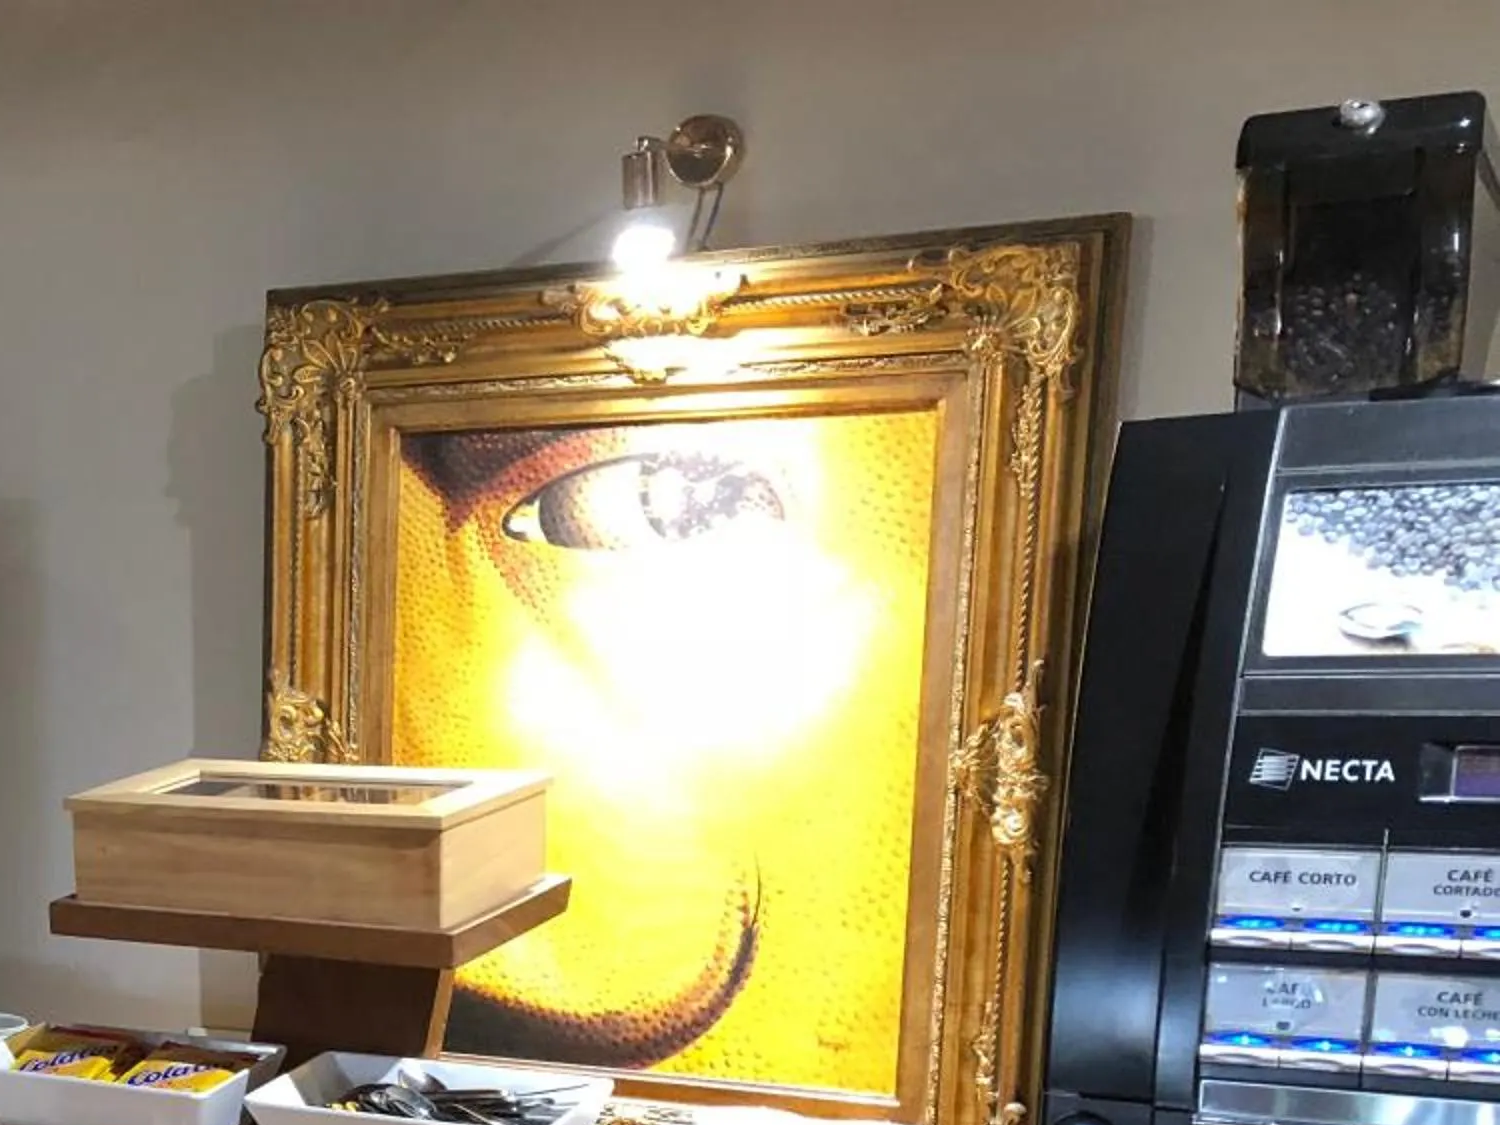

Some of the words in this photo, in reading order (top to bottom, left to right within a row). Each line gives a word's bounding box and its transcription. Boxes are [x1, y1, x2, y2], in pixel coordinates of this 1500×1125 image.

[1301, 759, 1395, 782] NECTA
[1298, 871, 1357, 887] CORTO
[1447, 868, 1494, 883] CAFÉ
[1436, 990, 1484, 1006] CAFÉ
[1418, 1005, 1450, 1018] CON
